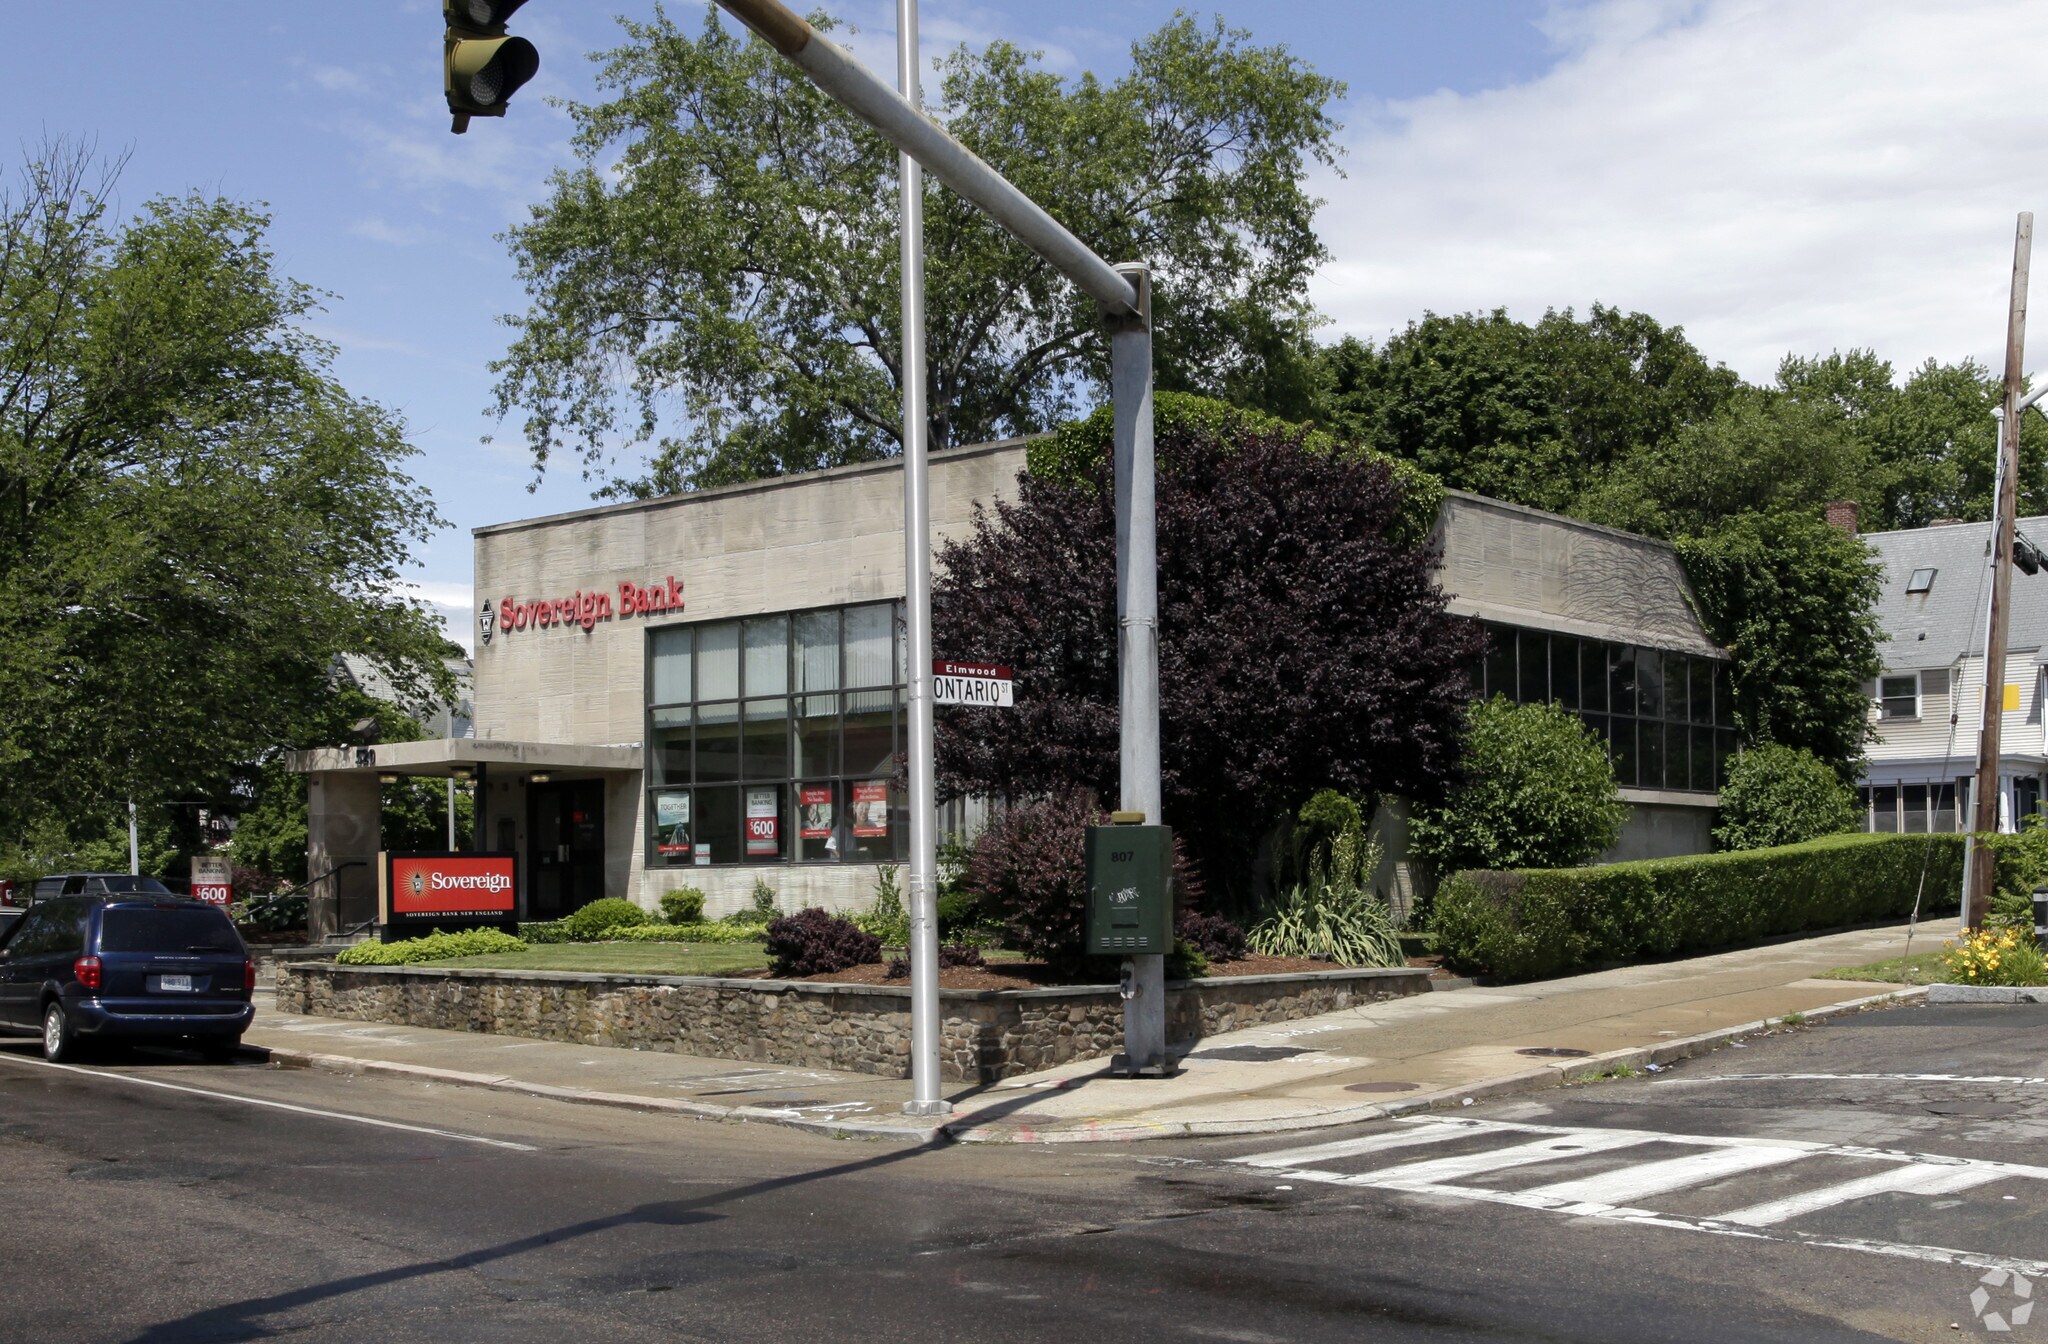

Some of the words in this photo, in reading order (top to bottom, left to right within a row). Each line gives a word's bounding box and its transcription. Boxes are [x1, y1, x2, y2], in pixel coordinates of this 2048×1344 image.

[500, 590, 611, 632] Sovereign
[618, 576, 685, 615] Bank
[945, 664, 996, 676] Elmwood
[933, 677, 1000, 703] ONTARIO
[1001, 682, 1009, 694] ST
[660, 803, 687, 811] TOGETHER
[750, 820, 775, 835] $600
[1111, 851, 1134, 862] 807
[431, 872, 511, 893] Sovereign
[196, 887, 227, 901] $600
